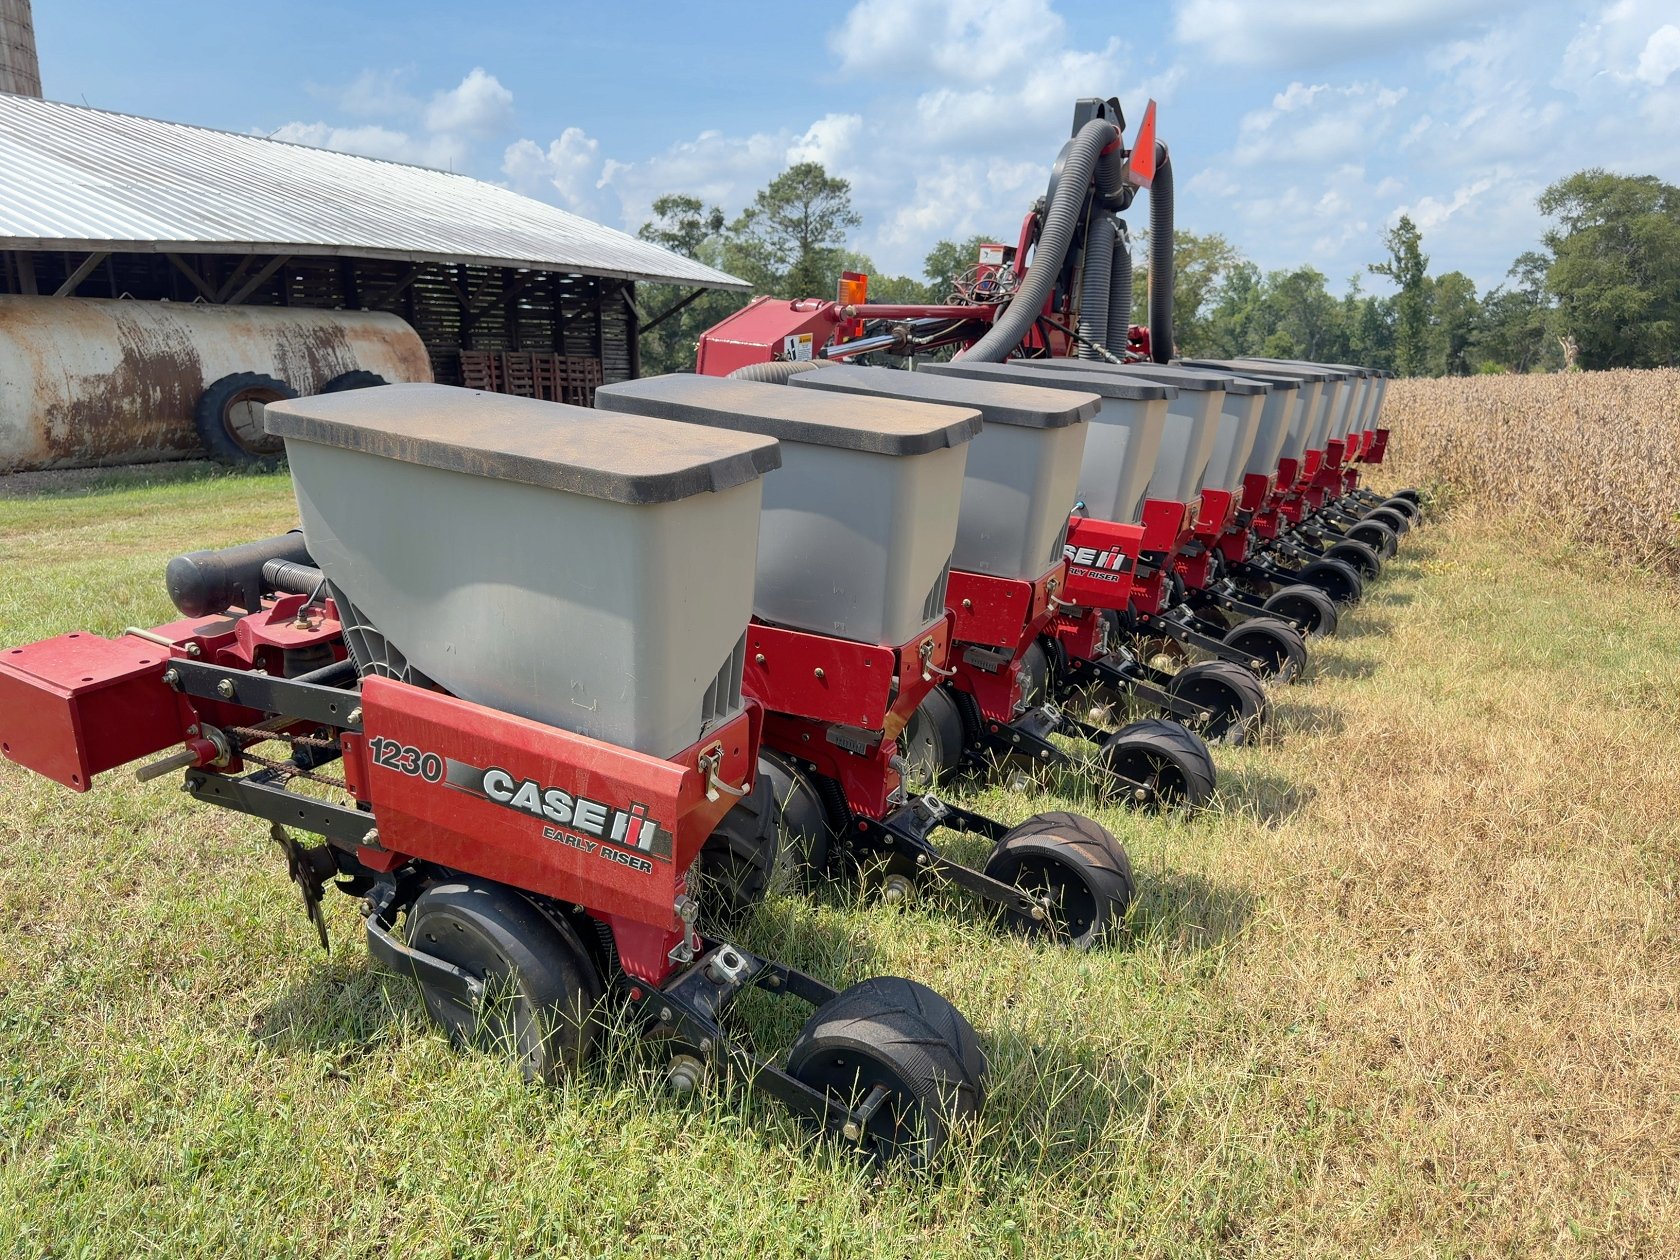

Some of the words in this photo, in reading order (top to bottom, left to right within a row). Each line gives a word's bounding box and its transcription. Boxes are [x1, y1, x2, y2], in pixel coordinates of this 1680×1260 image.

[1064, 544, 1097, 566] SE
[1069, 567, 1088, 577] RLY
[1088, 571, 1120, 582] RISER
[369, 736, 443, 783] 1230
[483, 769, 608, 836] CASE
[542, 826, 599, 853] EARLY
[599, 845, 653, 874] RISER
